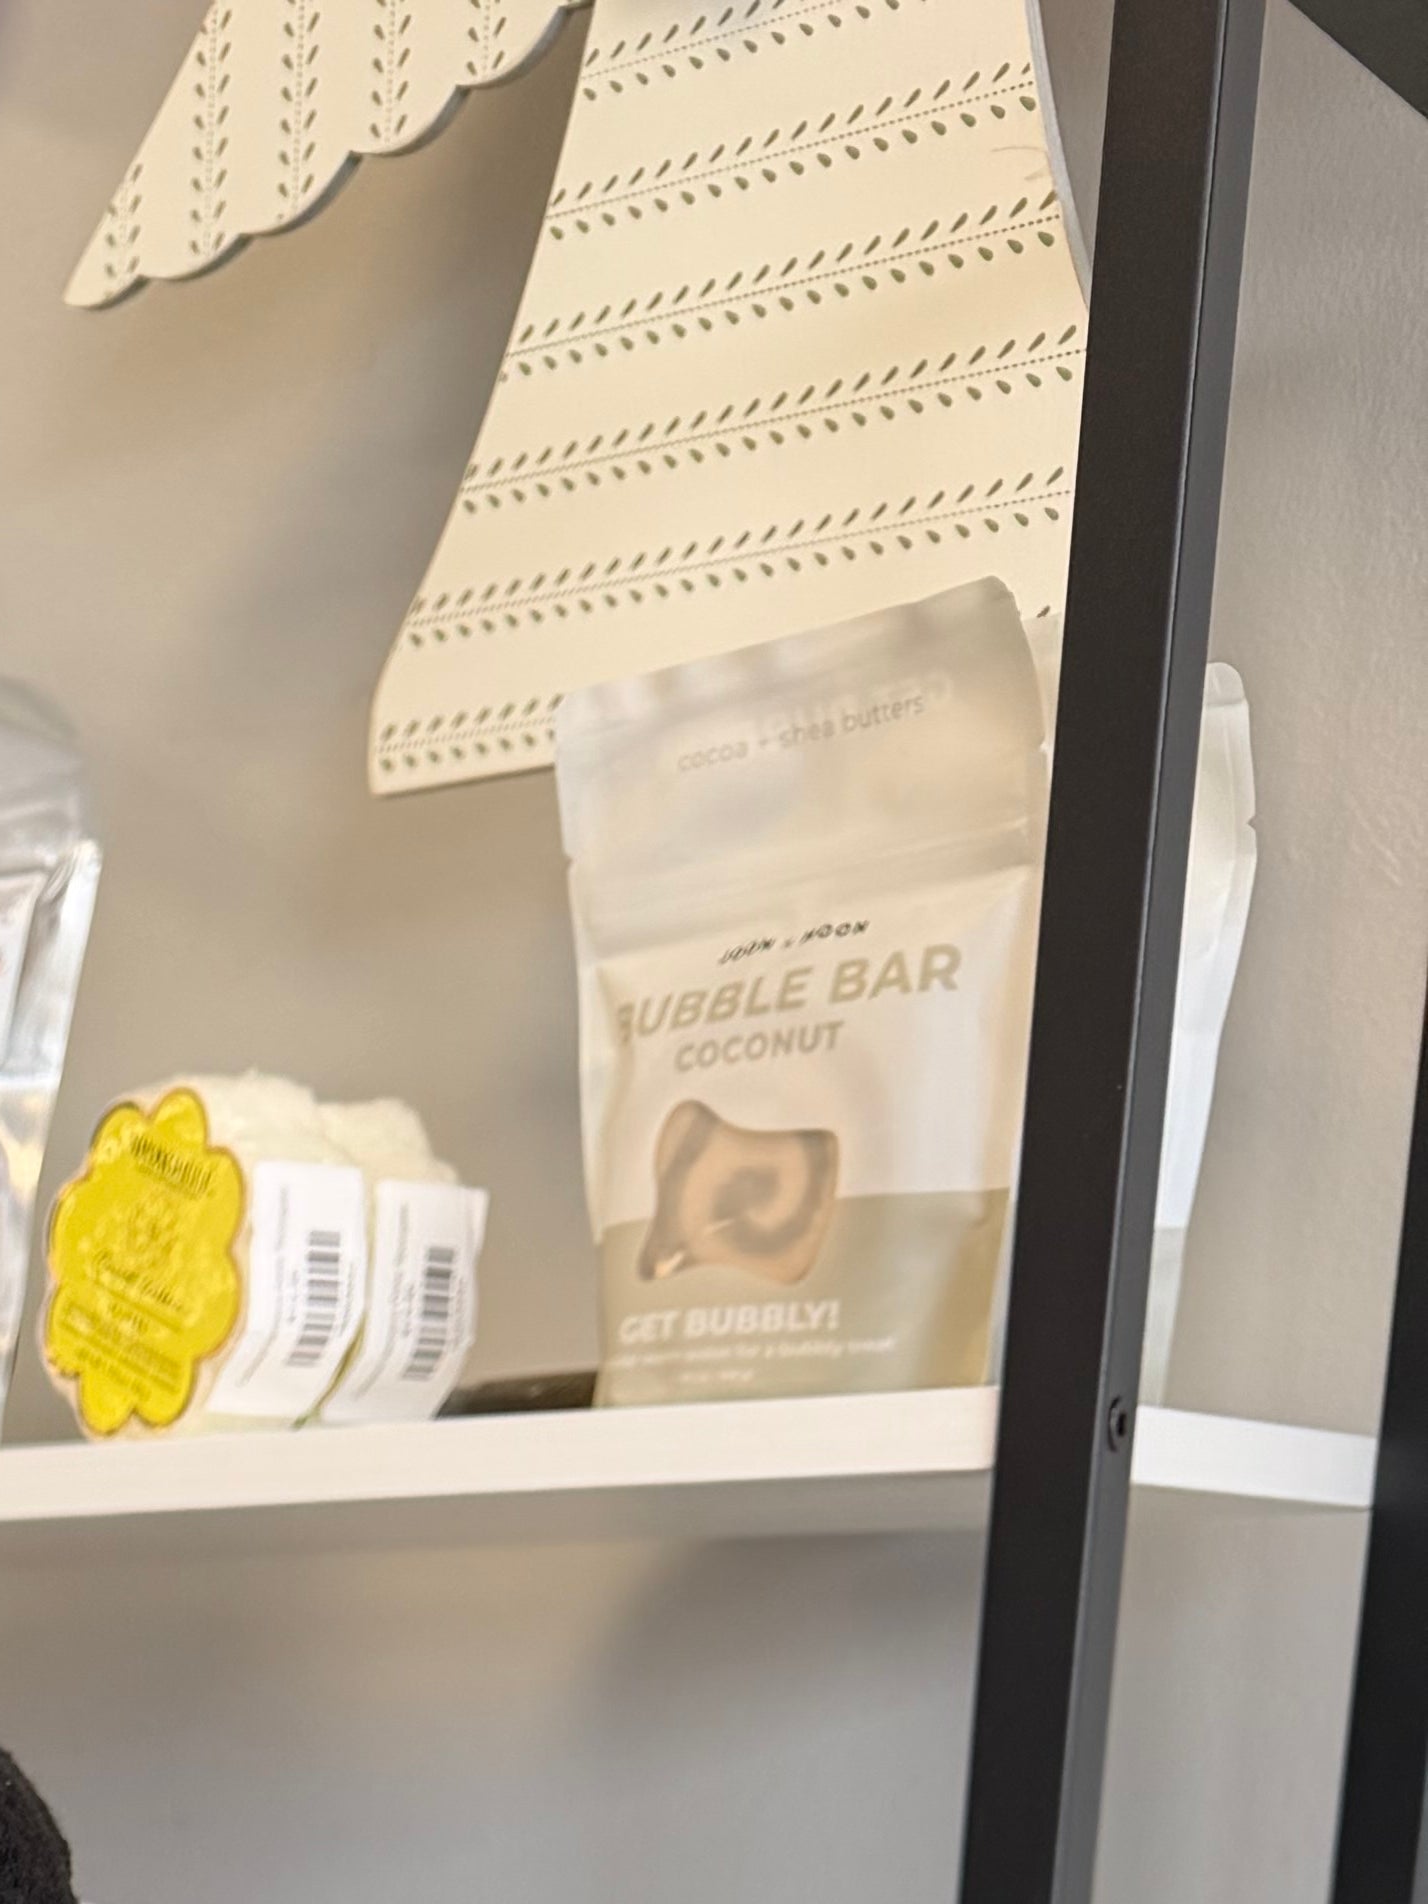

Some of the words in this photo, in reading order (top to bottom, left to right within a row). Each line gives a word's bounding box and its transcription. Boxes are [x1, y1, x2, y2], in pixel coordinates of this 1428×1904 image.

[677, 742, 749, 773] cocoa
[779, 719, 836, 748] shea
[842, 695, 925, 733] butters
[617, 964, 816, 1047] BUBBLE
[828, 943, 964, 1006] BAR
[674, 1020, 846, 1074] COCONUT
[618, 1309, 680, 1345] GET
[683, 1298, 843, 1339] BUBBLY!
